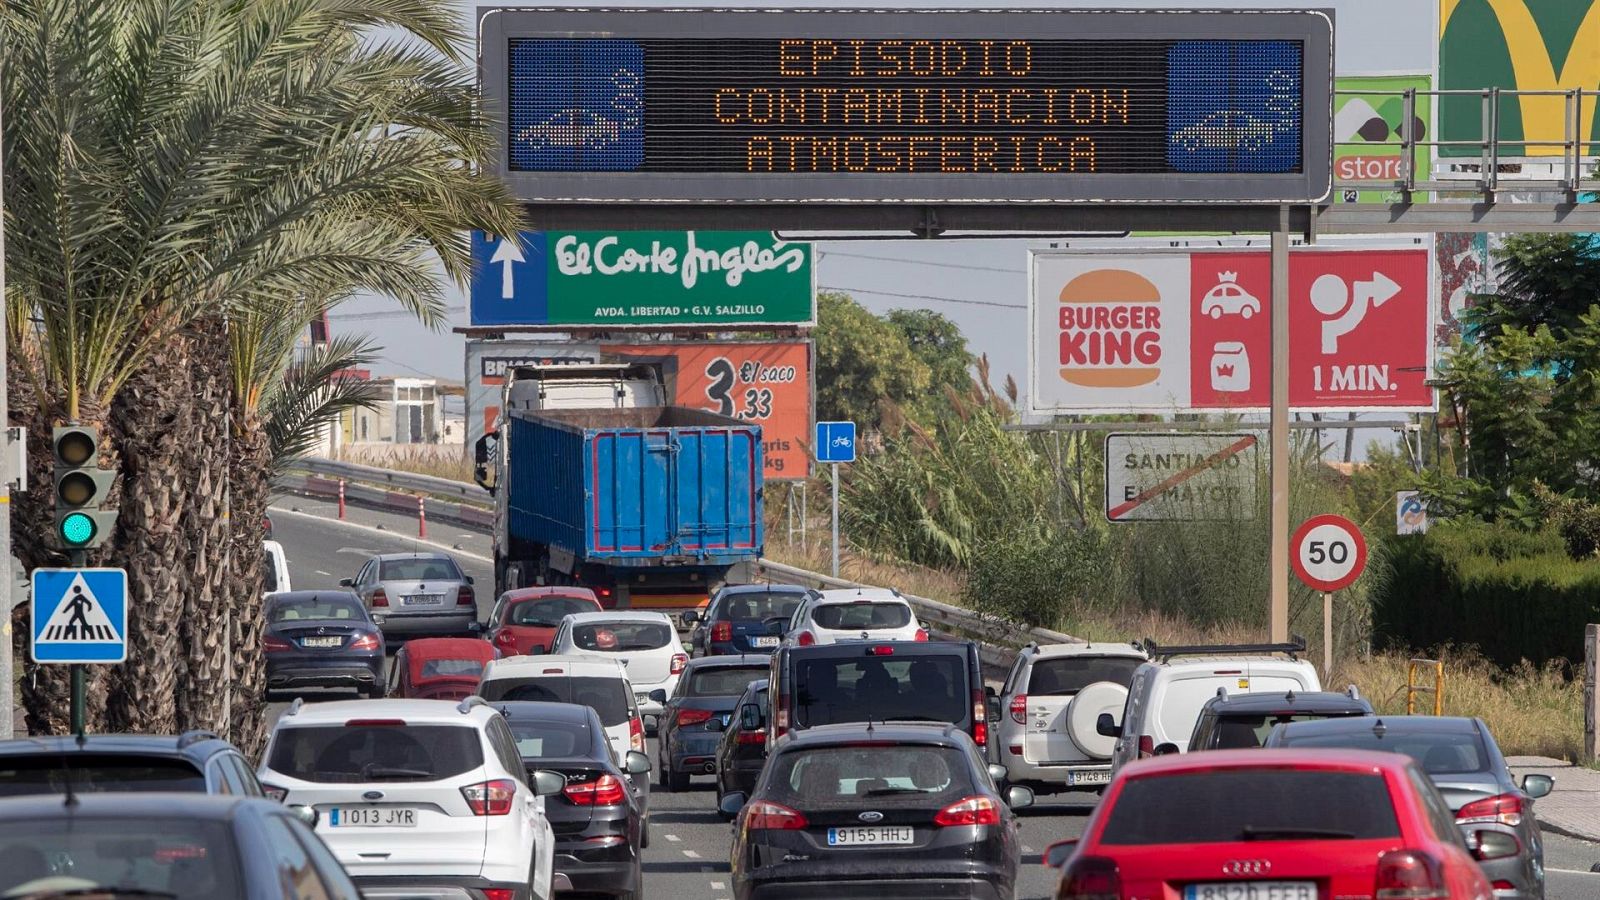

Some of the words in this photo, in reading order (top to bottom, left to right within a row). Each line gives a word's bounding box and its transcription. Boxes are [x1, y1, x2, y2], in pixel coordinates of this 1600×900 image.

[780, 40, 1031, 75] EPISODIO
[715, 87, 1128, 123] CONTAMINACION
[747, 135, 1096, 171] ATMOSFERICA
[555, 234, 592, 275] El
[593, 236, 678, 275] Corte
[594, 307, 628, 317] AVDA.
[631, 306, 680, 316] LIBERTAD
[692, 306, 712, 316] G.V.
[715, 305, 765, 315] SALZILLO
[1059, 305, 1161, 330] BURGER
[1059, 331, 1162, 365] KING
[1313, 365, 1322, 391] 1
[1330, 364, 1398, 391] MIN.
[1308, 541, 1348, 565] 50
[1075, 772, 1099, 782] 9148
[343, 809, 380, 824] 1013
[386, 809, 414, 824] JYR
[838, 829, 876, 843] 9155
[881, 828, 910, 841] HHJ
